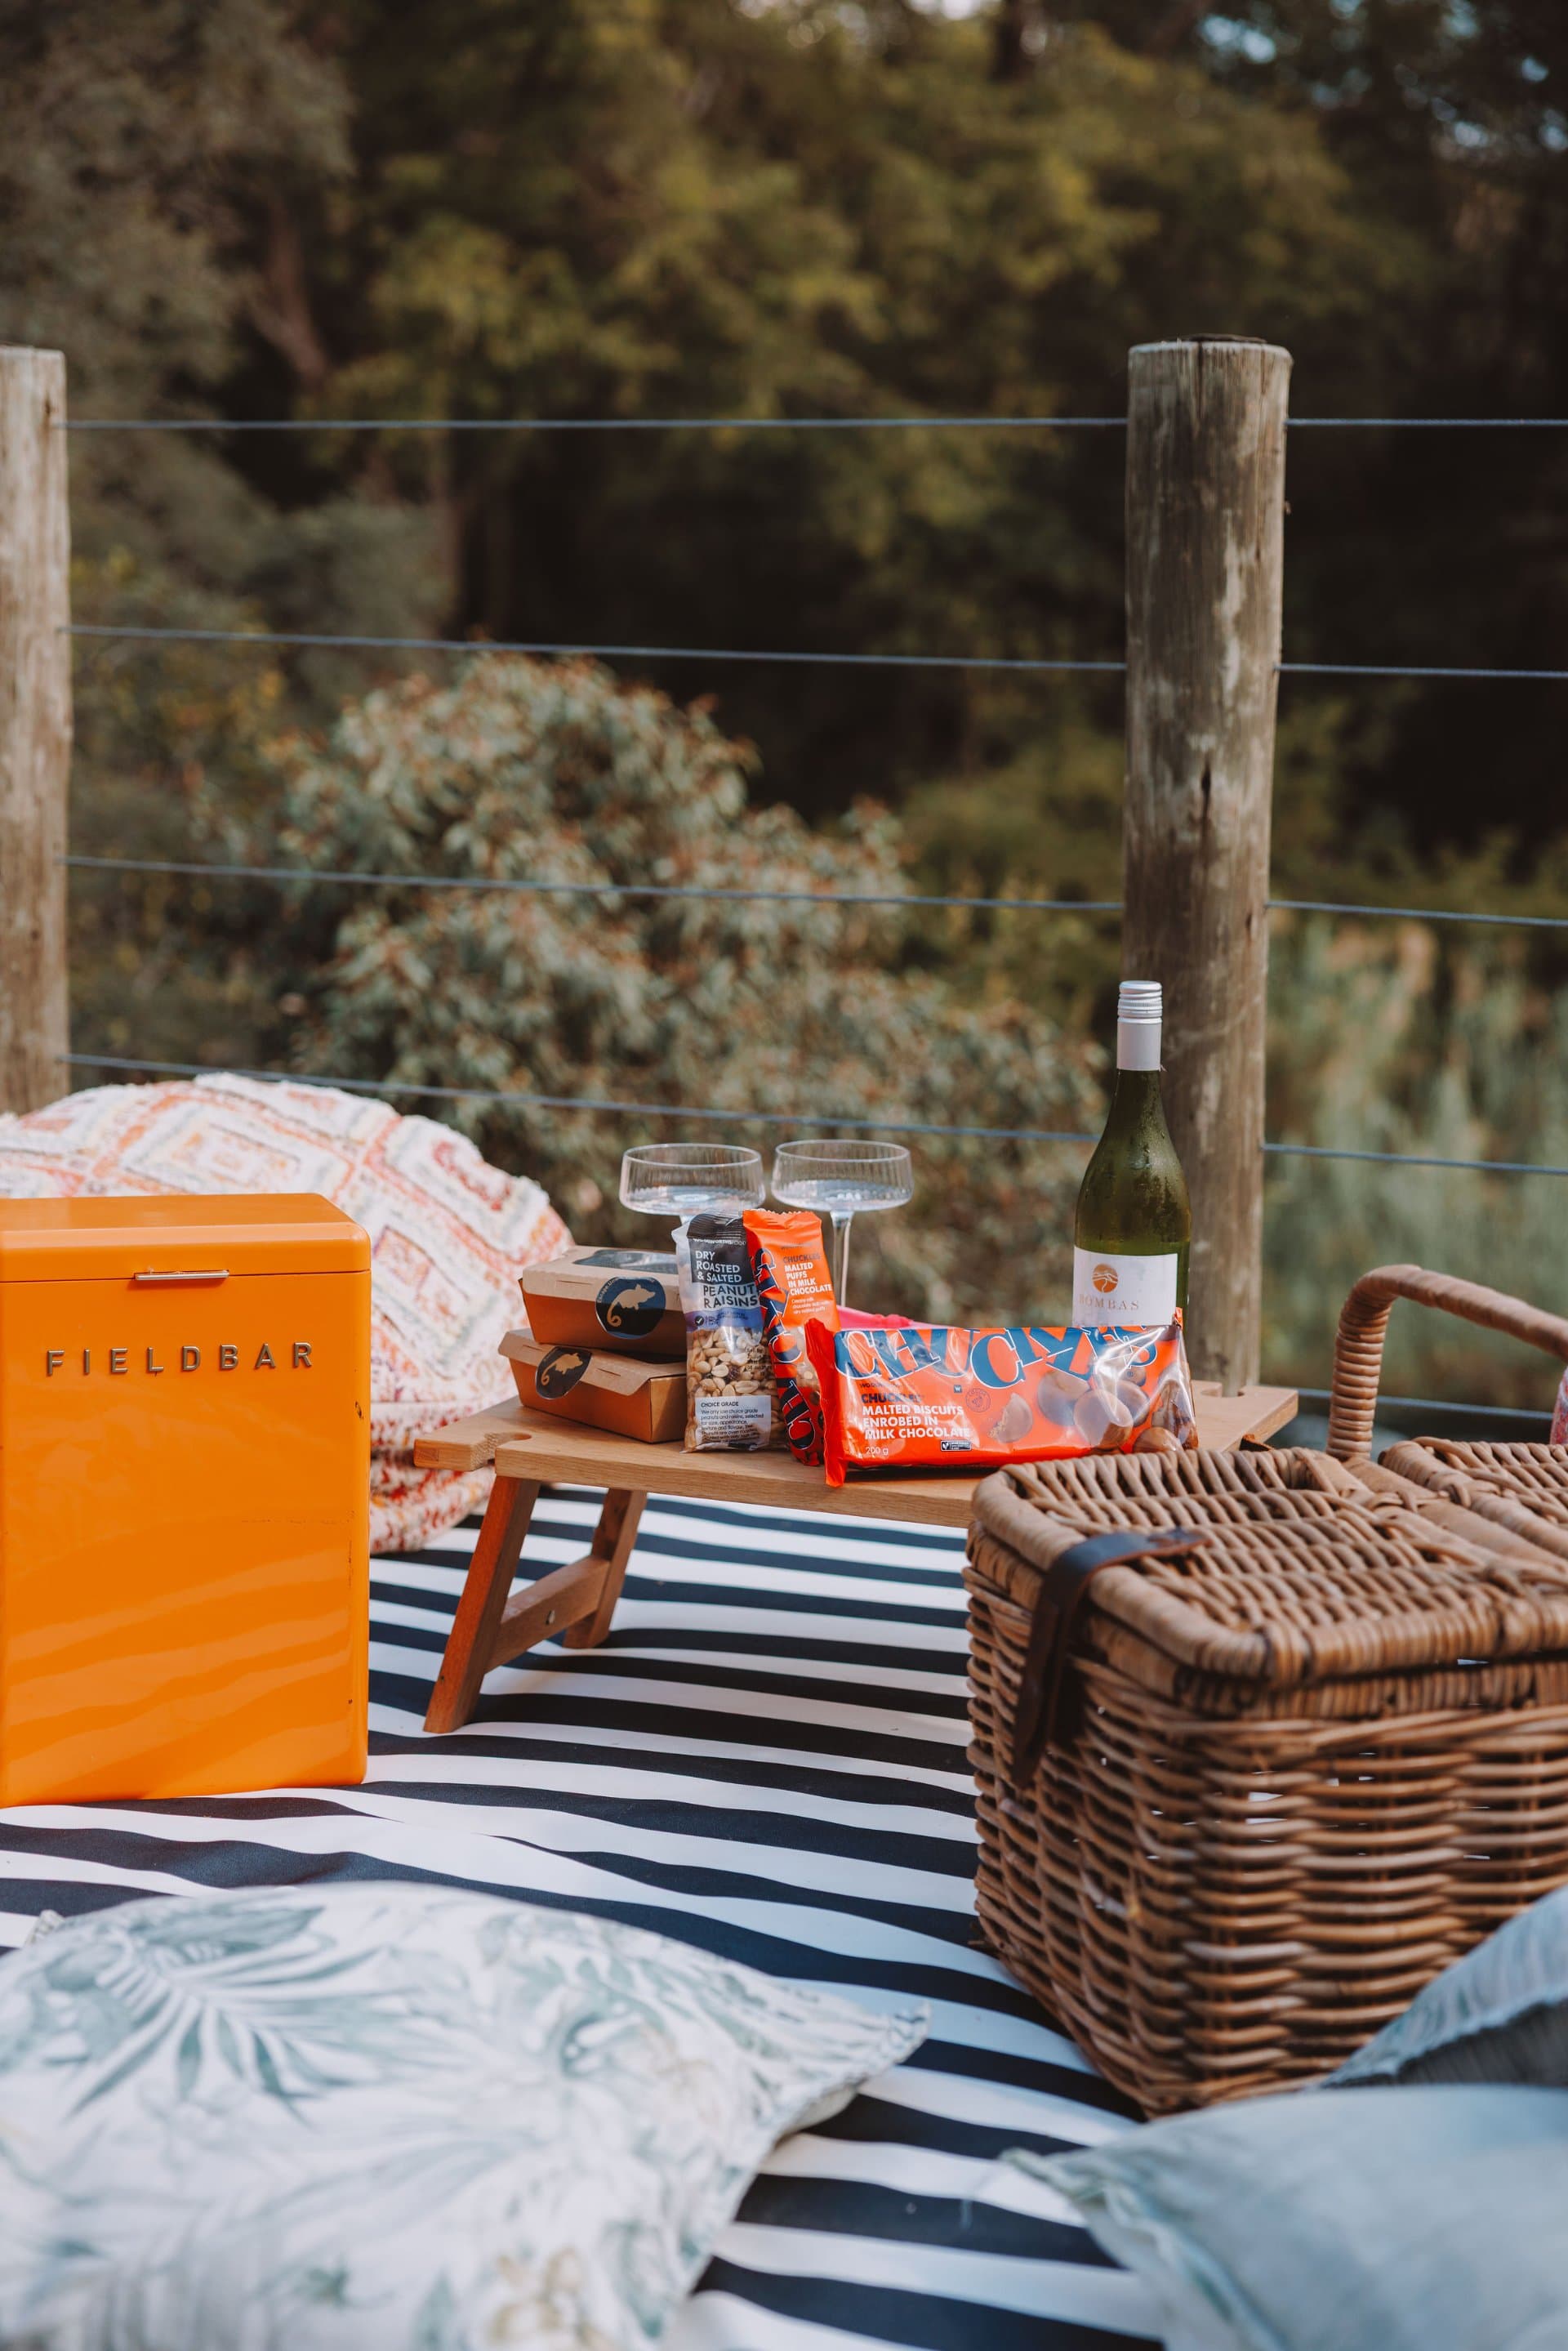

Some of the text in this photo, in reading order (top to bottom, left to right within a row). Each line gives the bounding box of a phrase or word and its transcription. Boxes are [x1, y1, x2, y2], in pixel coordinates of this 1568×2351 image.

[695, 1250, 715, 1260] DRY
[696, 1260, 741, 1274] ROASTED
[784, 1261, 813, 1272] MALTED
[697, 1271, 742, 1283] & SALTED
[786, 1271, 807, 1280] PUFFS
[788, 1278, 817, 1288] IN MILK
[703, 1283, 760, 1296] PEANUT
[790, 1283, 833, 1296] CHOCOLATE
[703, 1296, 758, 1308] RAISINS
[47, 1341, 313, 1376] FIELDBAR
[862, 1404, 964, 1416] MALTED BISCUITS
[862, 1416, 938, 1428] ENROBED IN
[865, 1427, 971, 1440] MILK CHOCOLATE
[866, 1446, 889, 1457] 200 g
